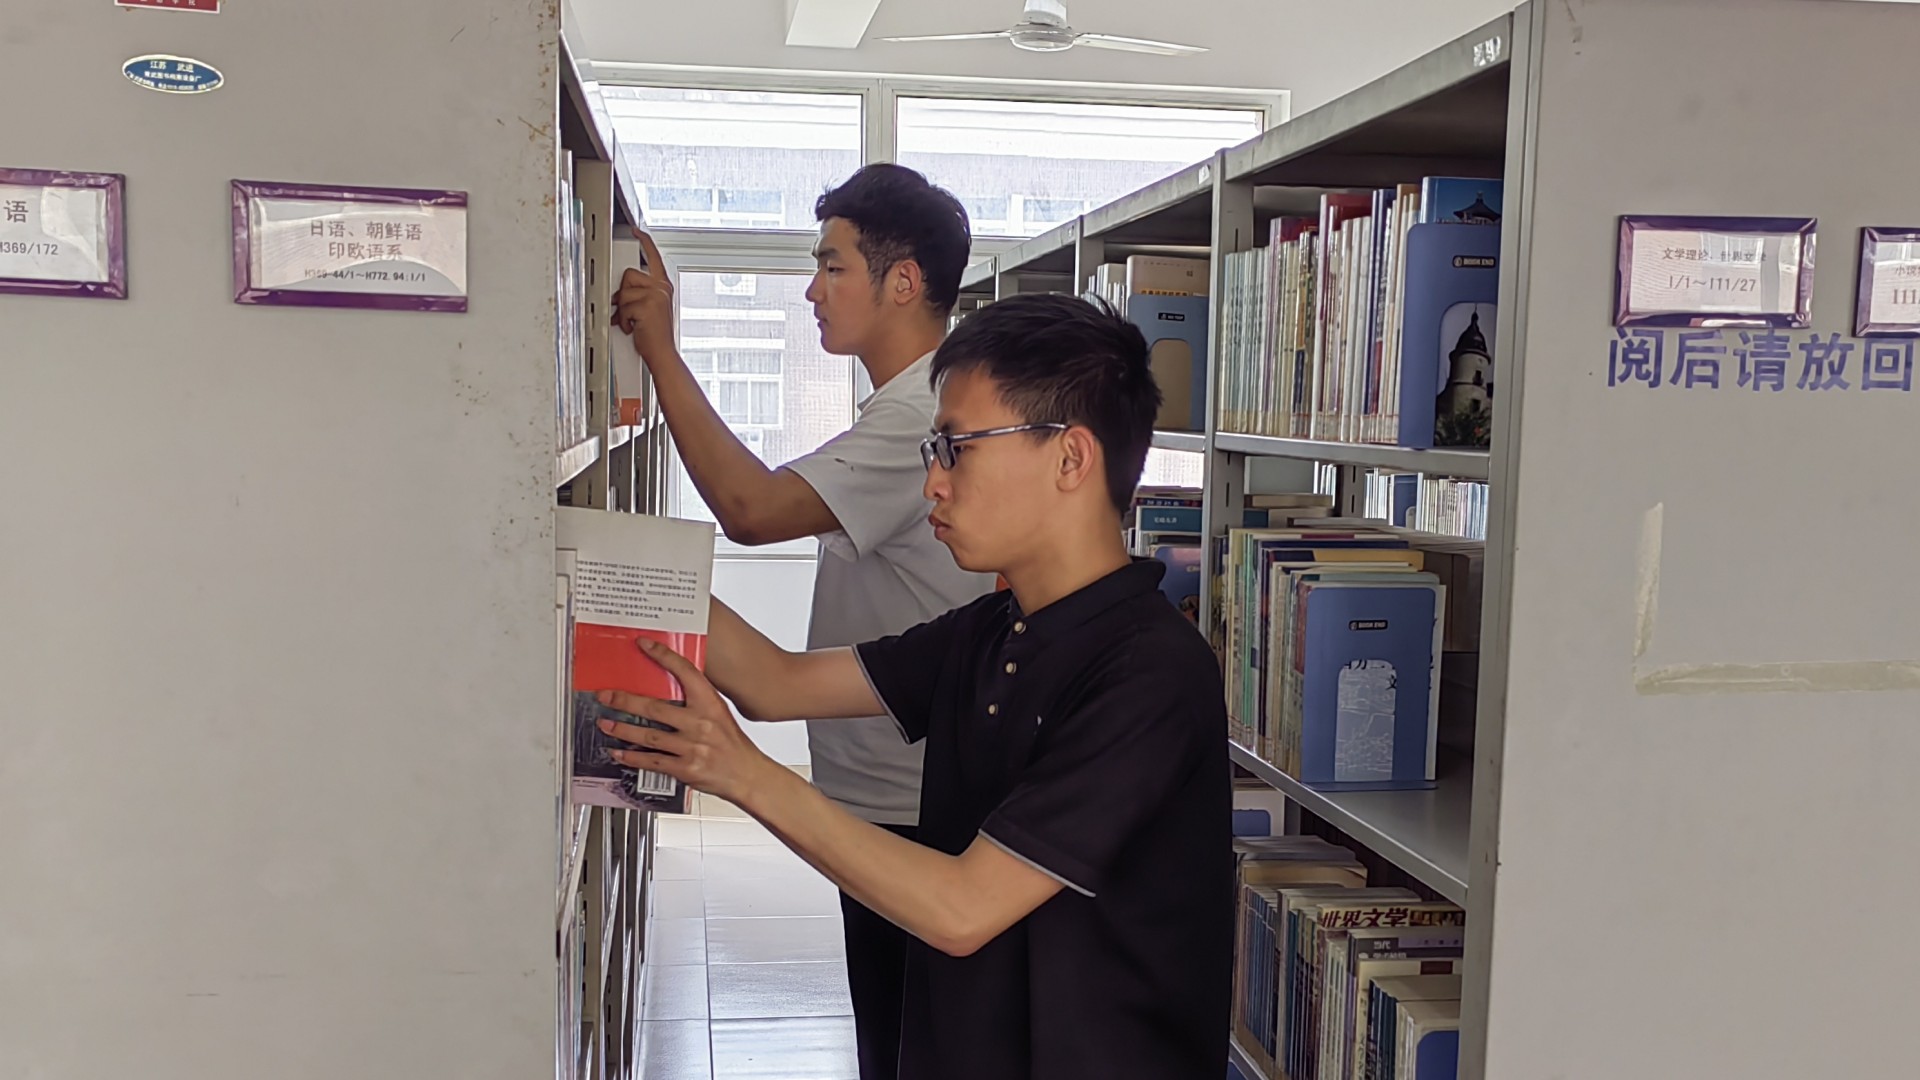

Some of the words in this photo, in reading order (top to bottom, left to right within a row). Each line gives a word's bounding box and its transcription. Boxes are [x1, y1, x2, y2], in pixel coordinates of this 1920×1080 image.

[3, 199, 29, 223] 语
[310, 220, 423, 241] 日语、朝鲜语
[329, 242, 403, 260] 印欧语系
[1607, 326, 1914, 392] 阅后请放回
[1321, 907, 1409, 928] 世界文学
